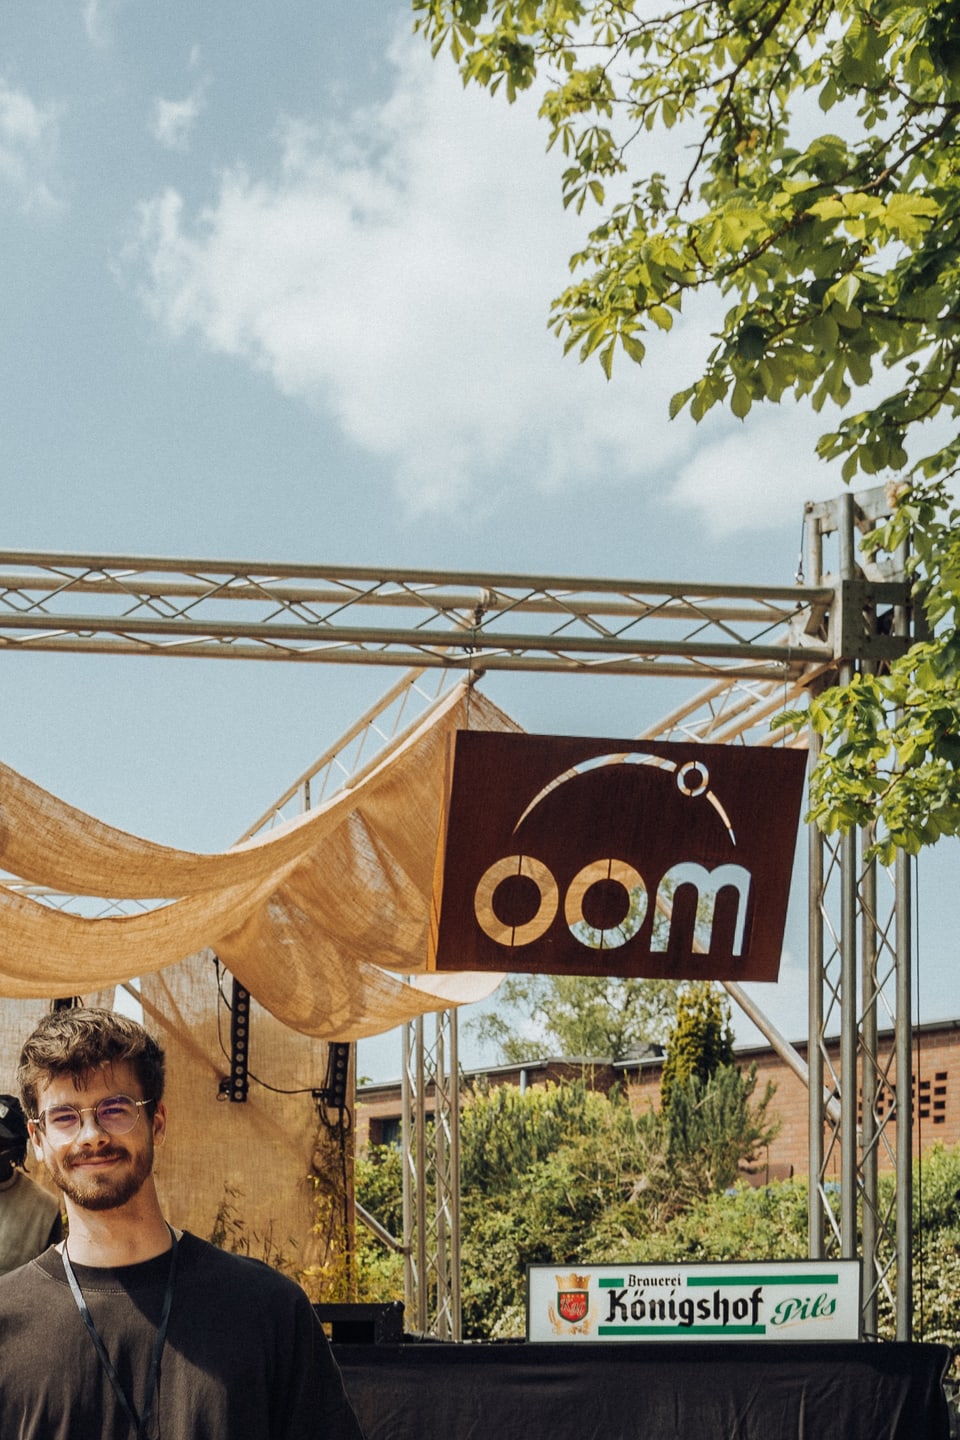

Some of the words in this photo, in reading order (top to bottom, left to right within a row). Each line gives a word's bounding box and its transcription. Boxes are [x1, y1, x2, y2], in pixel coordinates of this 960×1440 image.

[474, 854, 752, 957] oom
[628, 1273, 681, 1288] Brauerei
[605, 1287, 764, 1327] Königshof
[770, 1293, 836, 1325] Pils
